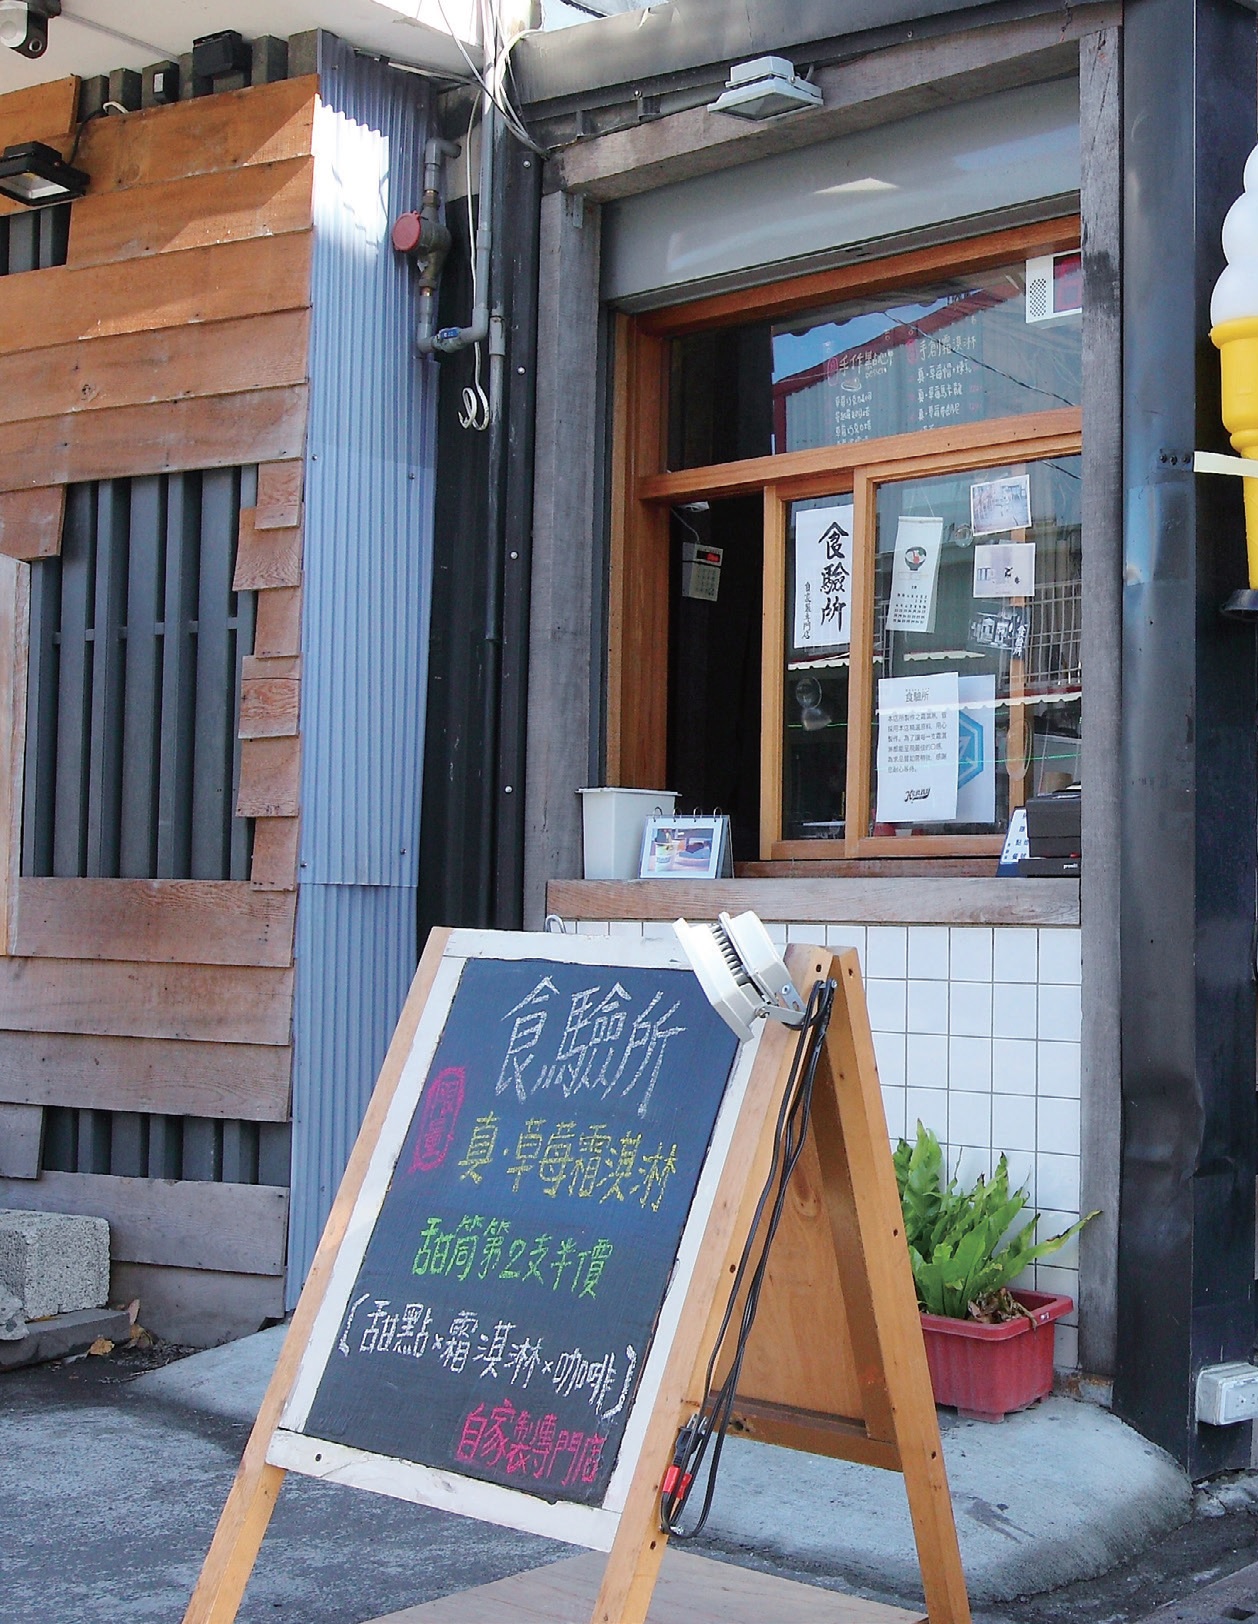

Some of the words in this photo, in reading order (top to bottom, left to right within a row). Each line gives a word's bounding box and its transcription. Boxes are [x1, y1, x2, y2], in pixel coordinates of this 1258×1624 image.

[818, 521, 850, 633] 食驗所
[495, 974, 687, 1118] 食驗所
